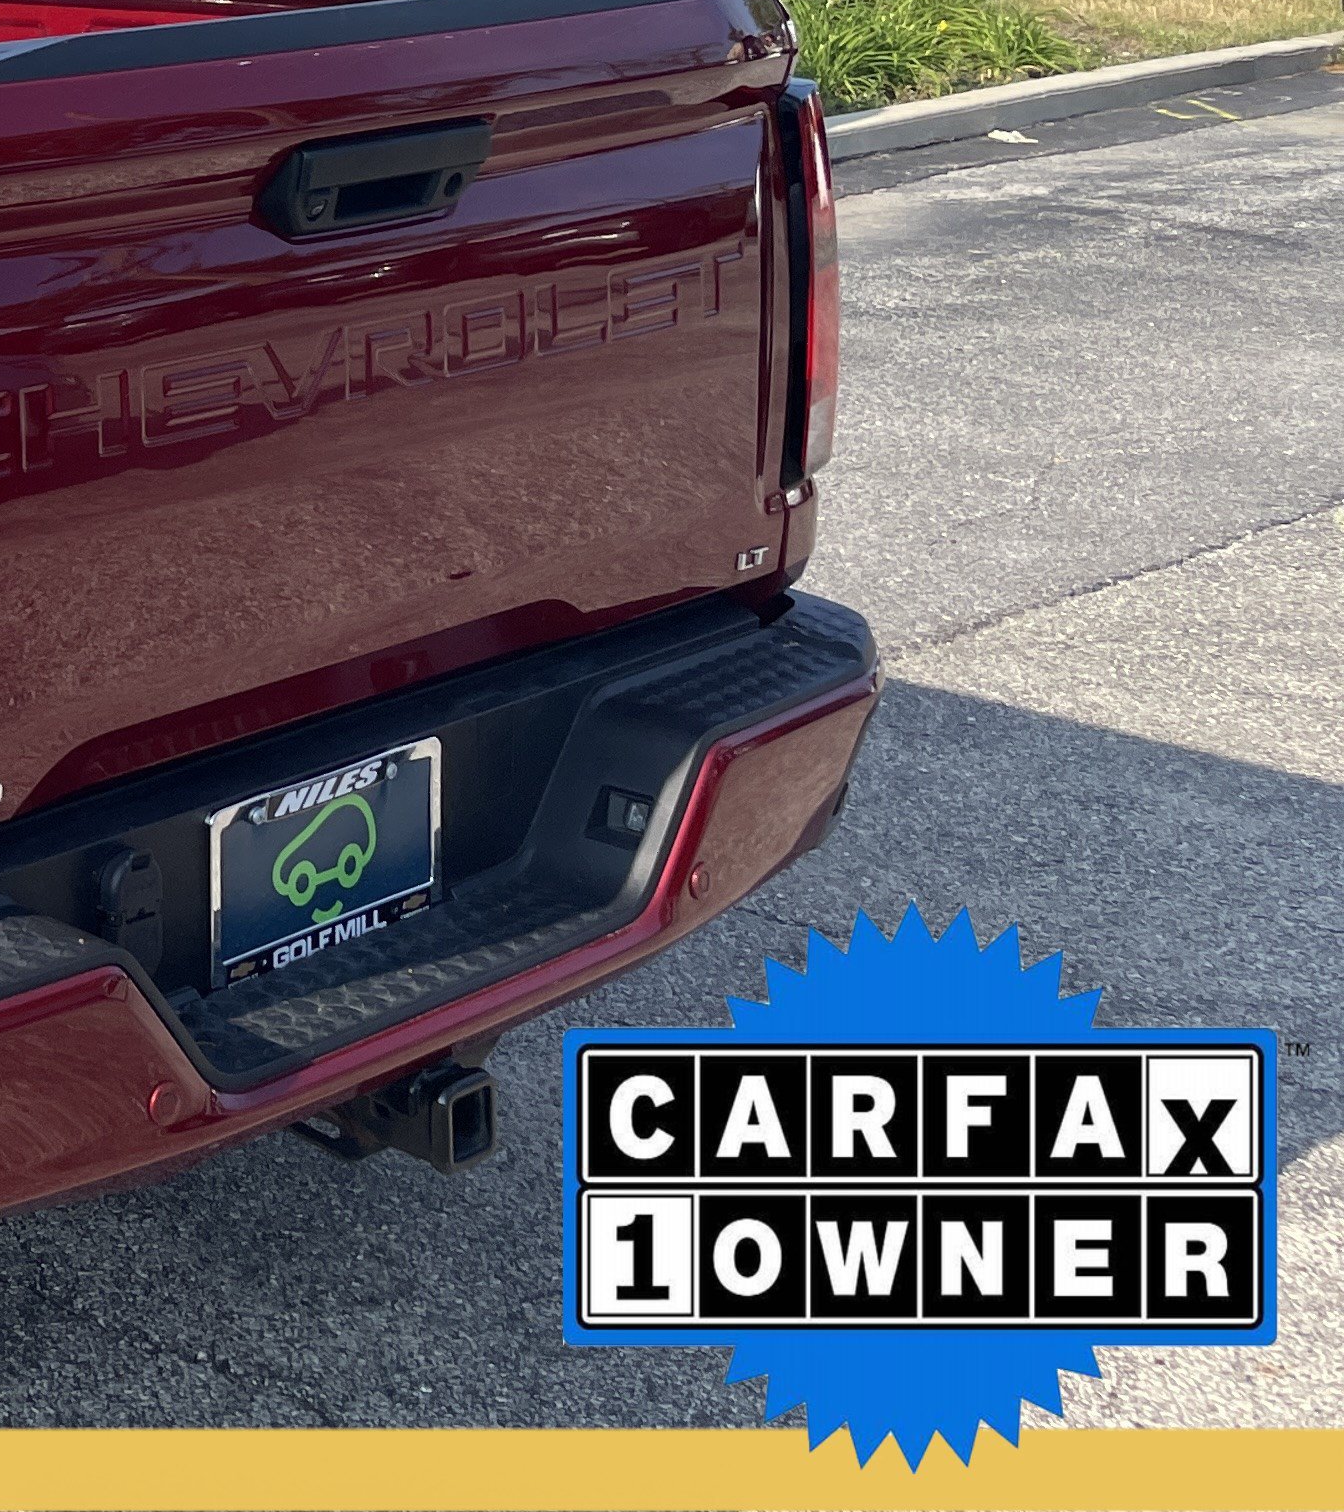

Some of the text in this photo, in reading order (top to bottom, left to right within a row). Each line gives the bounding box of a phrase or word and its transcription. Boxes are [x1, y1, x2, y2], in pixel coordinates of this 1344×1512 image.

[737, 547, 769, 571] LT
[274, 760, 383, 818] NILES
[272, 910, 388, 969] GOLF MILL
